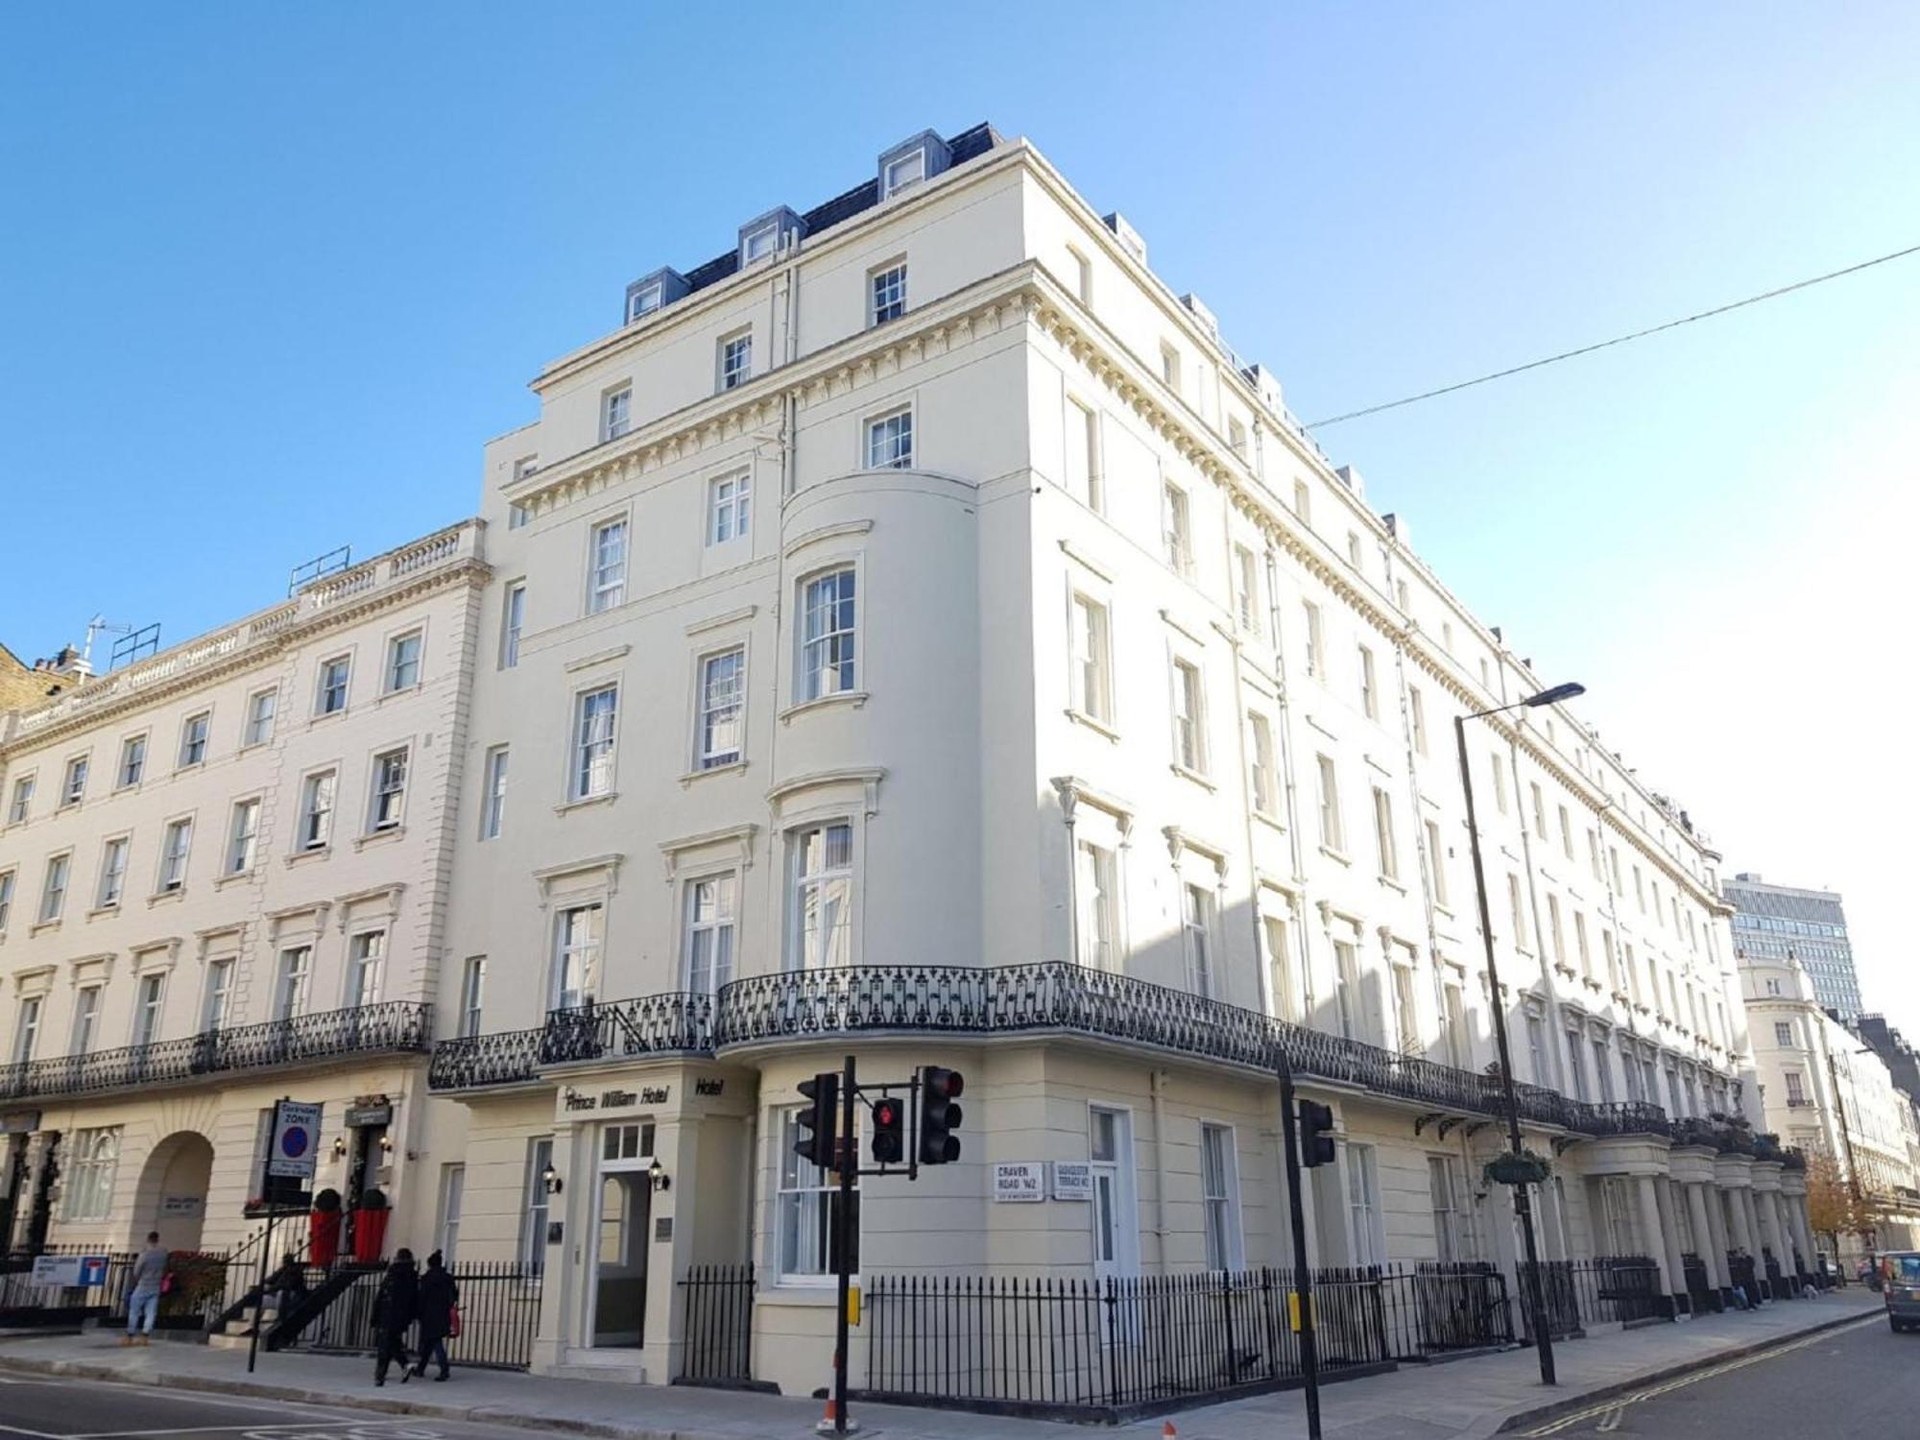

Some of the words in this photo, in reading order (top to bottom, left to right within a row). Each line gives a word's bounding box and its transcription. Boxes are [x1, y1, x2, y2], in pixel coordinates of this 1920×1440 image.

[695, 1078, 724, 1096] Hotel
[564, 1091, 597, 1112] Prince
[601, 1089, 637, 1108] William
[640, 1085, 671, 1105] Hotel
[998, 1166, 1029, 1177] CRAVEN
[998, 1179, 1020, 1189] ROAD
[1023, 1178, 1036, 1189] W2
